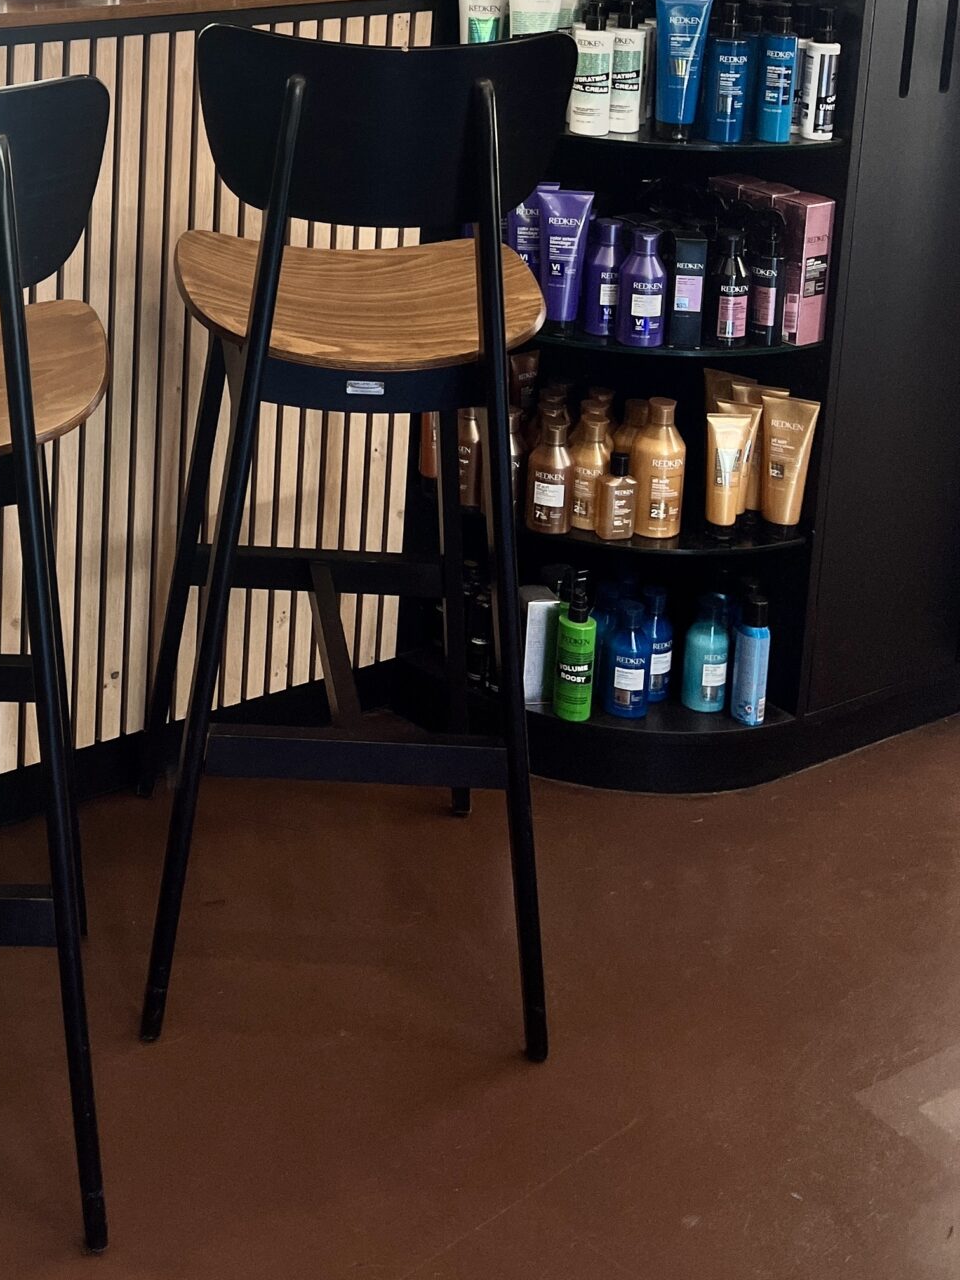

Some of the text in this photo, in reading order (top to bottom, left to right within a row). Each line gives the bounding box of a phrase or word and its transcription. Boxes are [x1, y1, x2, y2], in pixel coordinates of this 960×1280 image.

[669, 17, 701, 25] REDKEN
[766, 50, 794, 58] REDKEN
[549, 217, 581, 226] REDKEN
[633, 282, 663, 290] REDKEN
[771, 419, 804, 431] REDKEN
[652, 459, 684, 467] REDKEN
[535, 471, 564, 480] REDKEN
[616, 656, 645, 664] REDKEN
[560, 664, 589, 672] VOLUME
[560, 672, 587, 683] BOOST
